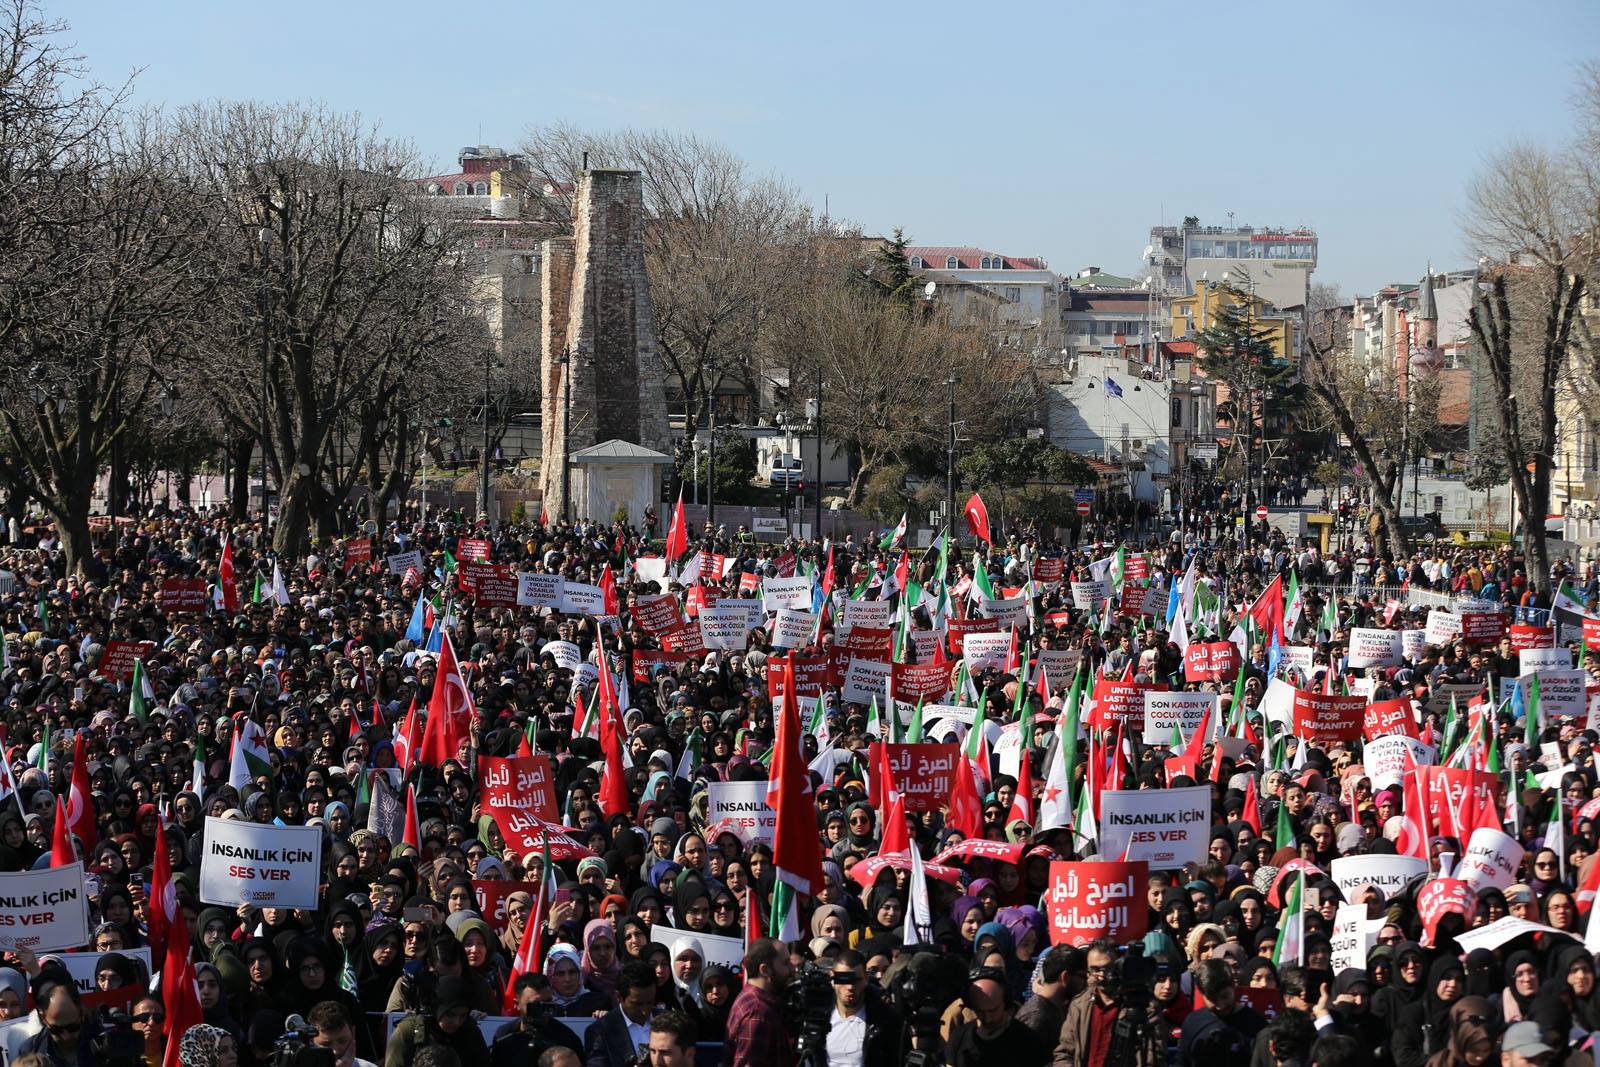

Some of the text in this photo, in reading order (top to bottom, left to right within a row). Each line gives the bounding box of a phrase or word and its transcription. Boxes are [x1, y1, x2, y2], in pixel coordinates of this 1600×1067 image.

[650, 605, 674, 618] WOMAN
[1212, 648, 1232, 660] اصرخ
[851, 674, 878, 684] ÇOCUK
[897, 671, 949, 682] LAST WOMAN
[854, 684, 881, 692] OLANA
[920, 680, 943, 689] CHILD
[1104, 695, 1126, 703] LAST
[1296, 697, 1309, 707] BE
[1311, 700, 1331, 710] THE
[1382, 707, 1406, 727] اصرخ
[1301, 719, 1355, 730] HUMANITY
[878, 750, 952, 776] اصرخ لأج
[1376, 756, 1405, 766] İNSAN
[485, 764, 545, 791] اصرخ لأجل
[490, 790, 546, 813] الإنسانية
[716, 801, 772, 812] İNSANLIK
[1110, 809, 1204, 825] İNSANLIK İÇİN
[1131, 830, 1187, 842] SES VER
[212, 840, 312, 864] İNSANLIK İÇİN
[229, 865, 290, 880] SES VER
[1474, 861, 1496, 878] VER
[1053, 870, 1134, 906] اصرخ لأجل
[1340, 875, 1400, 889] İNSANLIK
[0, 888, 77, 908] NLIK İÇİN
[0, 912, 54, 926] ES VER
[1055, 906, 1128, 936] الإنسانية
[1343, 922, 1356, 932] VE
[1332, 937, 1357, 952] ZGÜR
